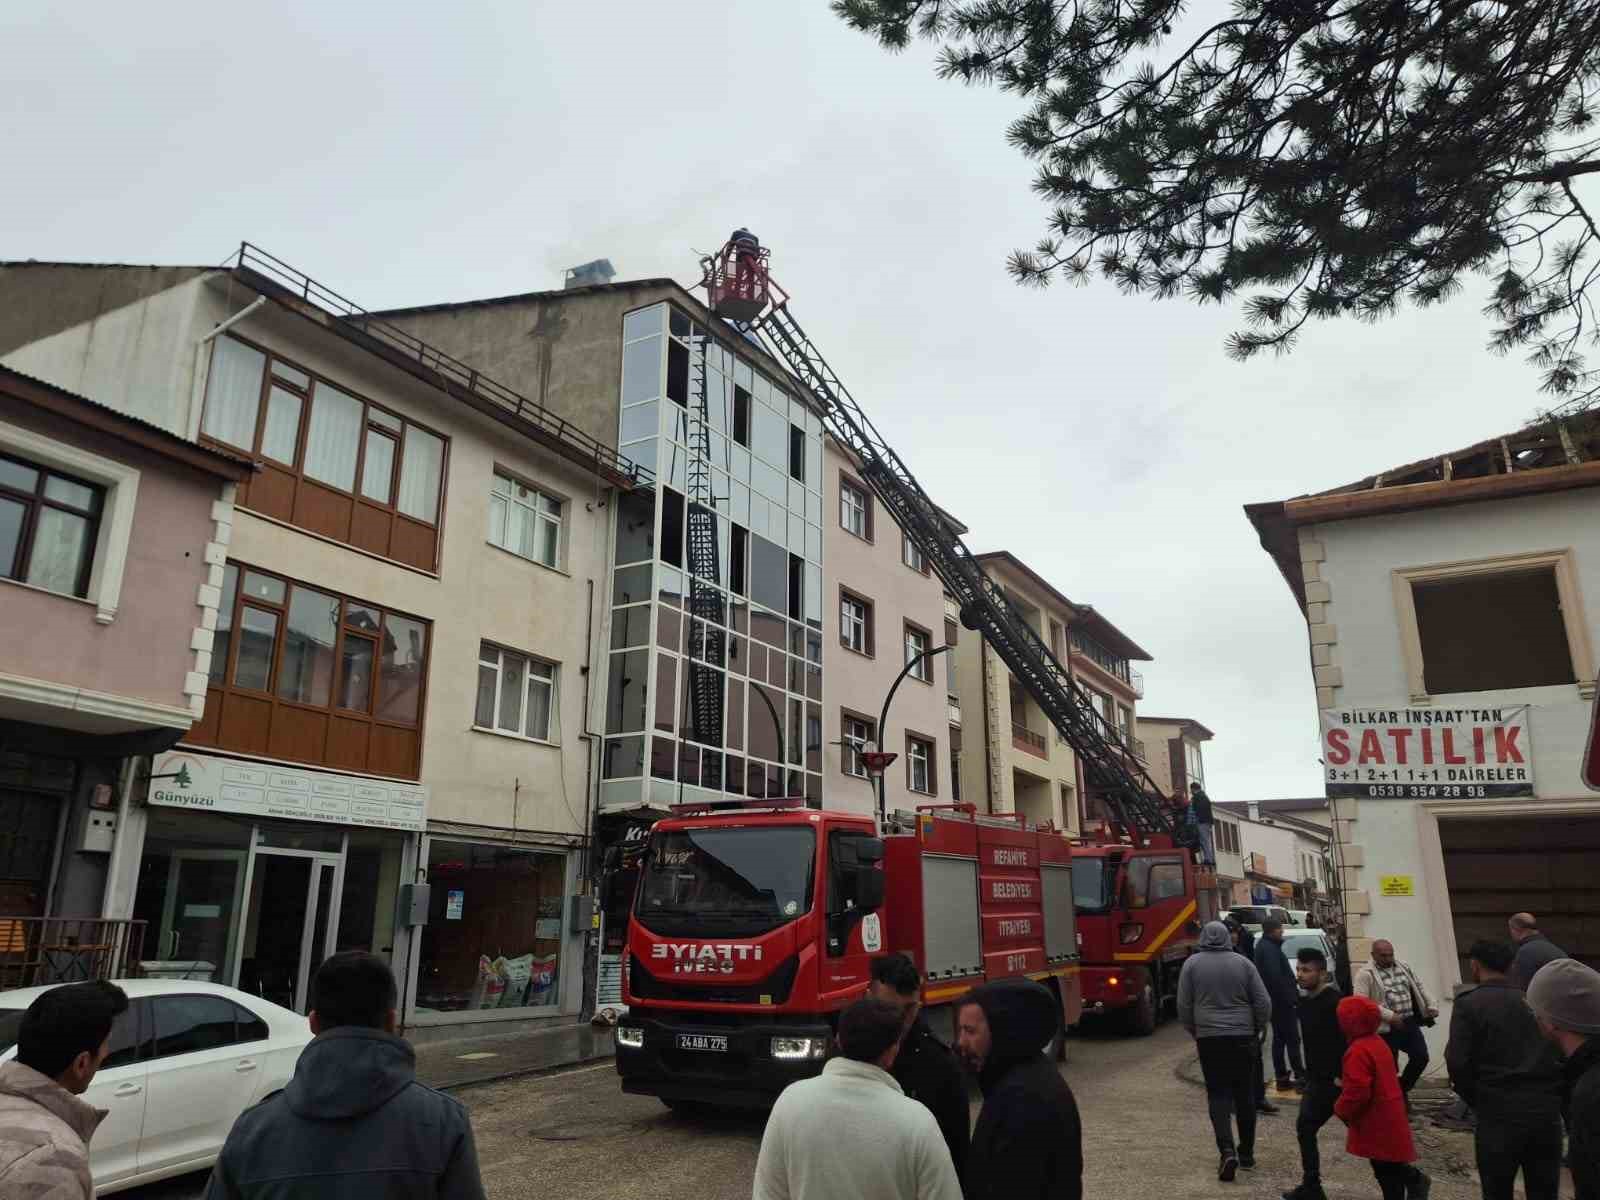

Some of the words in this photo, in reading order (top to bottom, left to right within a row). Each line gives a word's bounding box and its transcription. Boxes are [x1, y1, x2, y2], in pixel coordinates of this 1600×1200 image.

[1342, 709, 1398, 724] BİLKAR
[1406, 708, 1502, 725] İNŞAAT'TAN
[1327, 726, 1525, 765] SATILIK
[1329, 768, 1360, 781] 3+1
[1368, 768, 1399, 781] 2+1
[1408, 768, 1440, 781] 1+1
[1448, 767, 1526, 781] DAİRELER
[154, 790, 214, 806] Günyüzü
[1410, 785, 1436, 797] 354
[1442, 785, 1461, 797] 28
